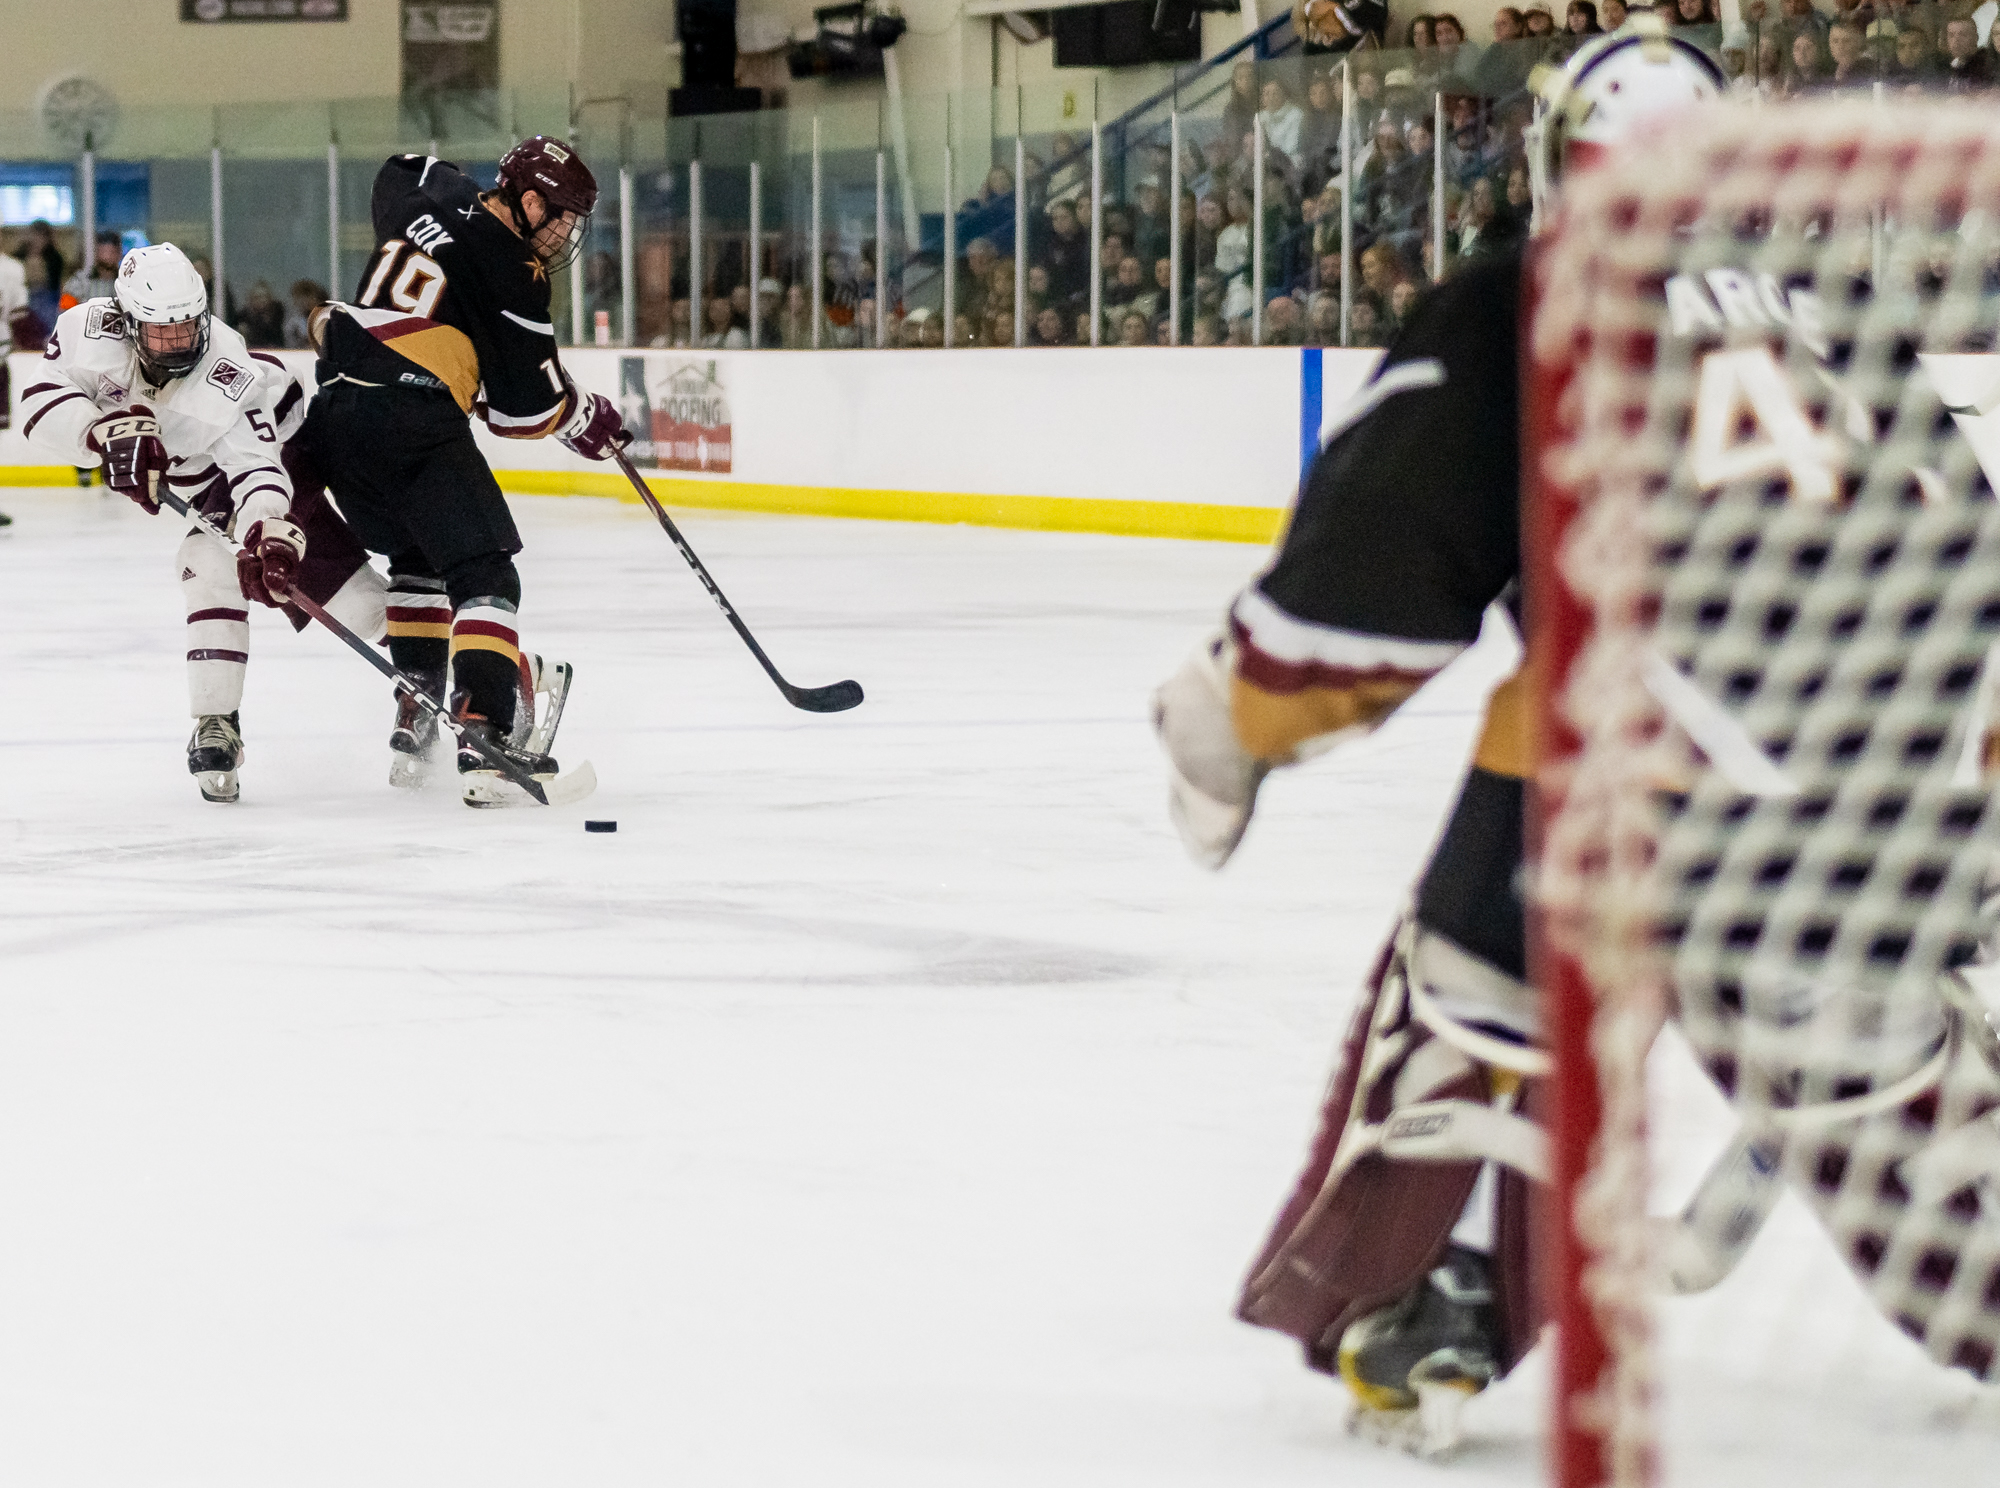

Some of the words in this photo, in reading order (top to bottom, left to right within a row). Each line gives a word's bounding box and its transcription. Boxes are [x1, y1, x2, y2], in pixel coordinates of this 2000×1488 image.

[535, 172, 559, 188] CCM
[405, 214, 454, 257] COX
[359, 239, 447, 320] 19
[245, 407, 277, 443] 5
[391, 673, 466, 737] CCM
